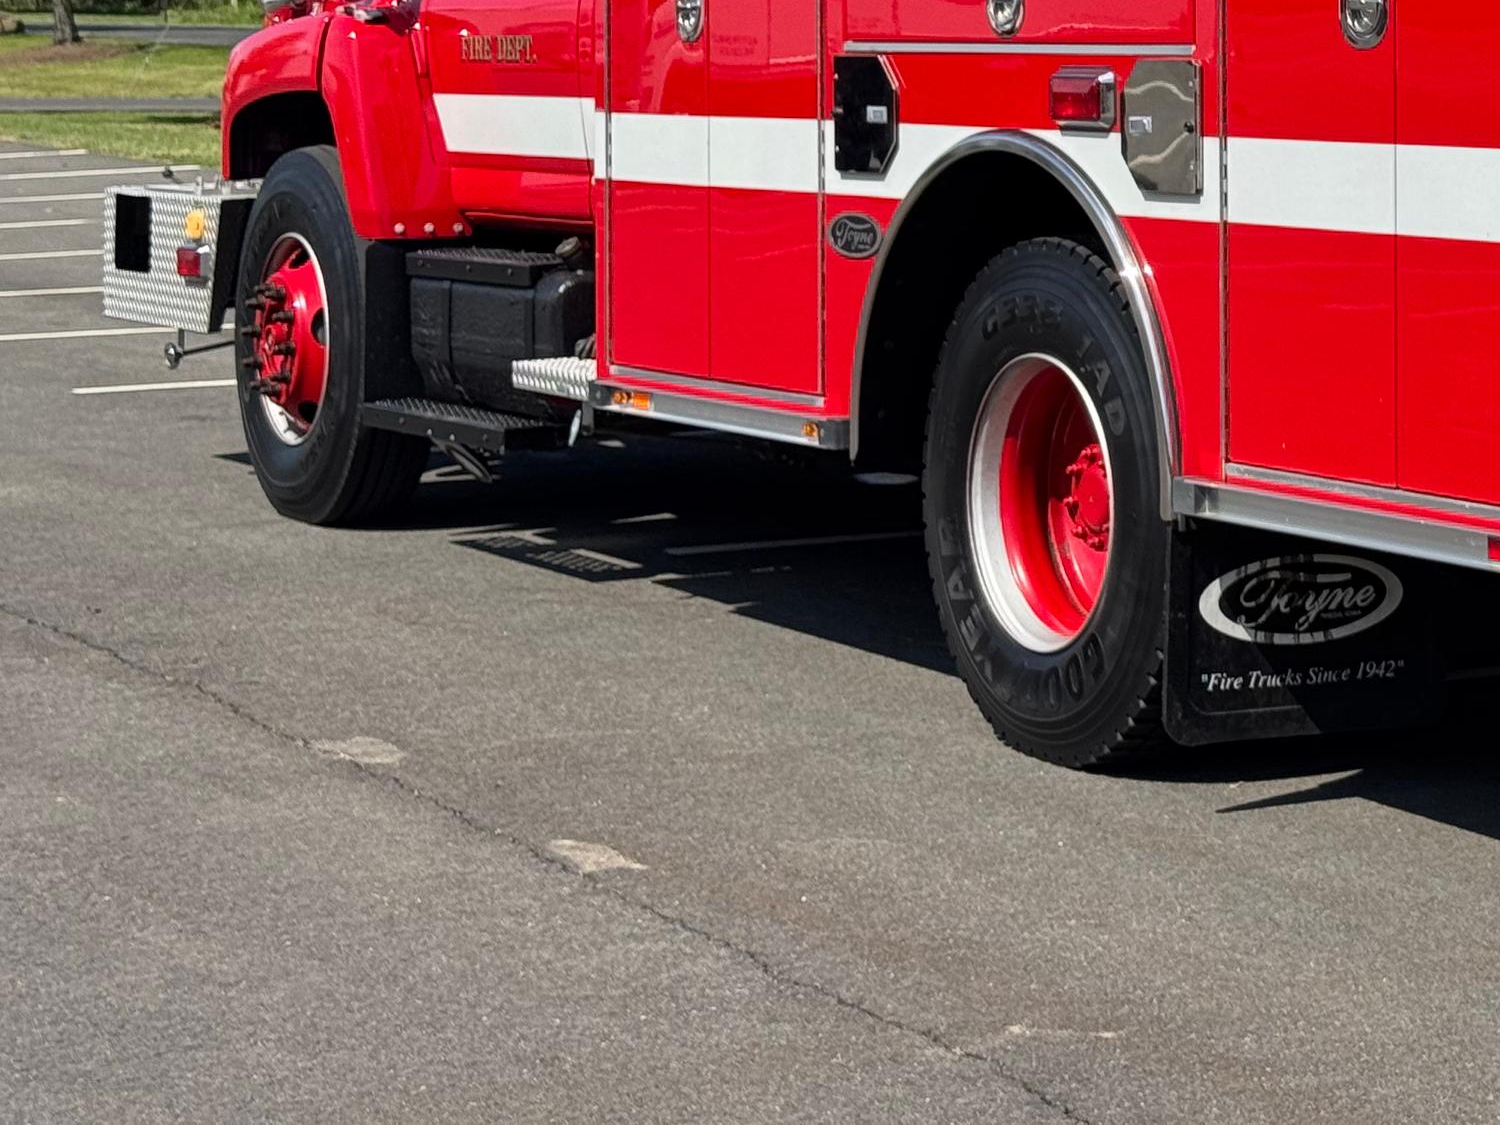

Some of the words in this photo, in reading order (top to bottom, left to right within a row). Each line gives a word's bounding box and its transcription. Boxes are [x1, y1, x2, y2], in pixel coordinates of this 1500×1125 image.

[461, 35, 493, 62] FIRE
[495, 34, 538, 64] DEPT.
[835, 218, 875, 251] Toyne
[1236, 570, 1377, 632] Toyne
[1201, 672, 1244, 692] "Fire
[1249, 668, 1302, 690] Trucks
[1306, 666, 1351, 686] Since
[1356, 659, 1405, 680] 1942"
